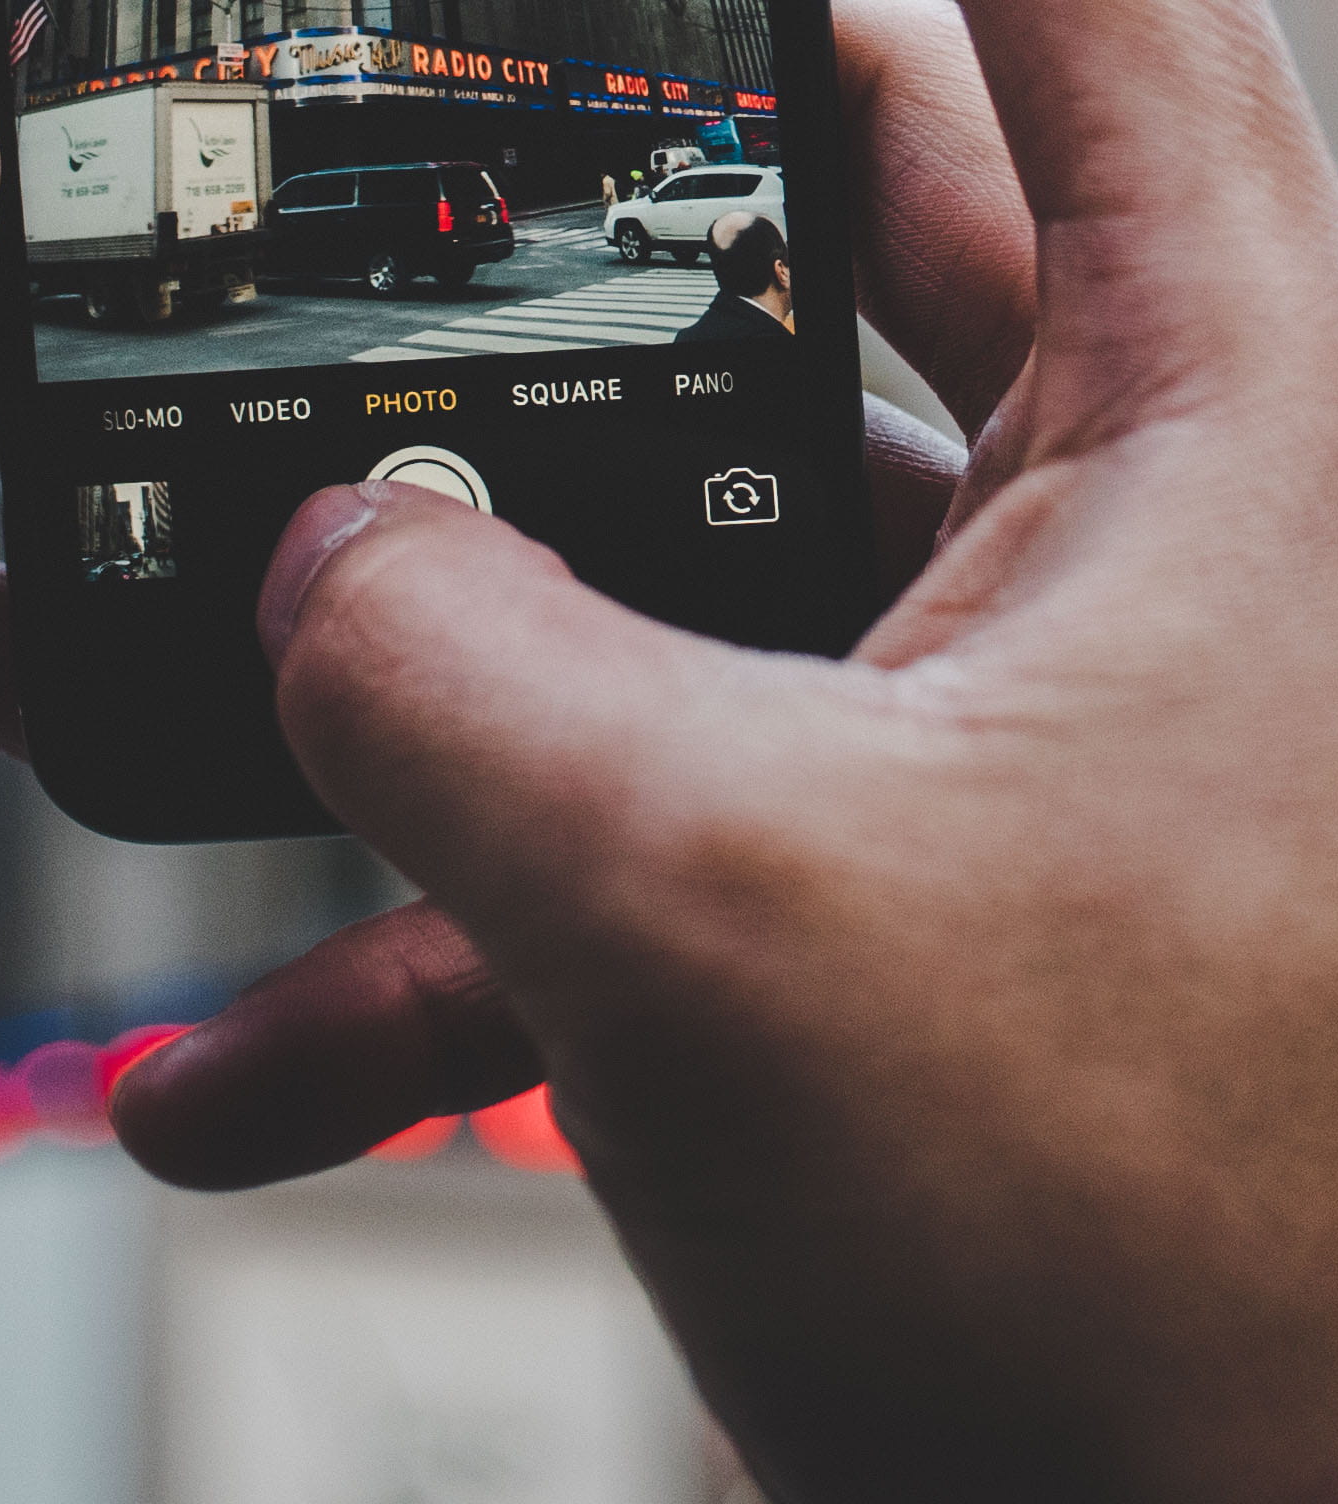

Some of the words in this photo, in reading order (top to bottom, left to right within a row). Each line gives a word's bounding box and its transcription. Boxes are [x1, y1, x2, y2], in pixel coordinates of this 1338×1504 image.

[412, 43, 492, 82] RADIO
[501, 57, 549, 87] CITY
[605, 72, 649, 97] RADIO
[662, 80, 689, 101] CITY
[103, 406, 183, 431] SLO-MO
[230, 398, 311, 424] VIDEO
[365, 388, 457, 415] PHOTO
[512, 378, 622, 407] SQUARE
[675, 372, 734, 396] PANO
